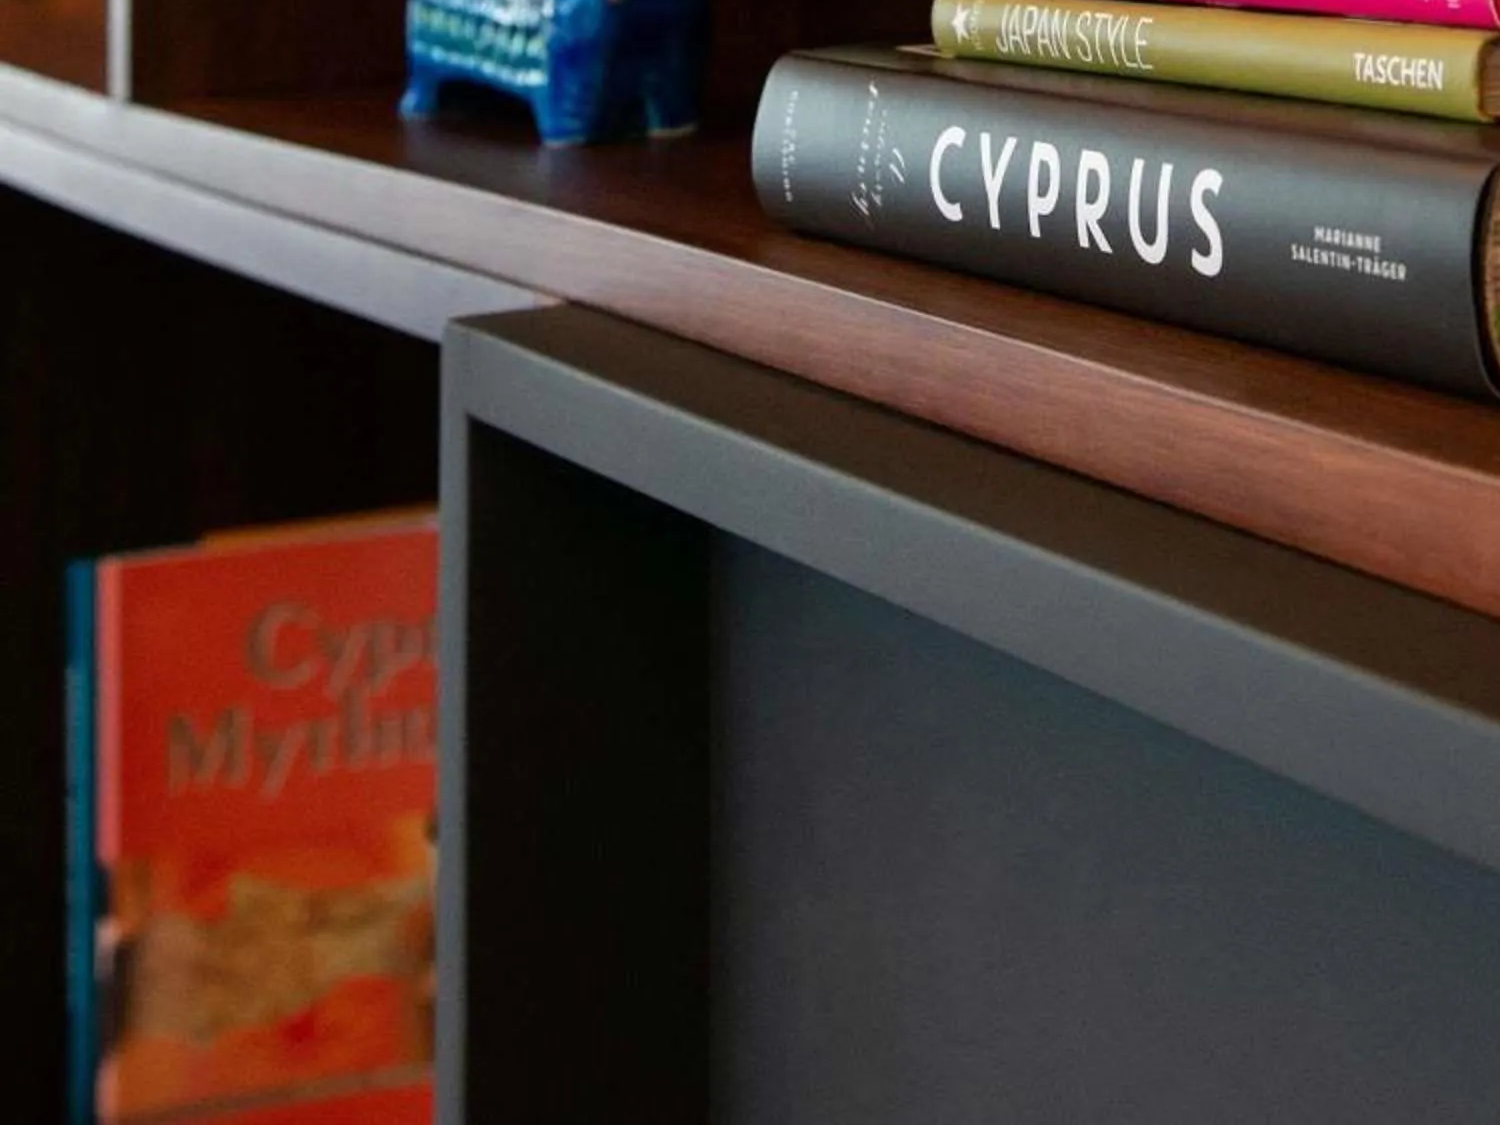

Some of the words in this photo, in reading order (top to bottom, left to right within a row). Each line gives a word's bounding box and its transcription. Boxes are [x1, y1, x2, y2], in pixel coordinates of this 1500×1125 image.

[996, 3, 1072, 60] JAPAN
[1075, 10, 1154, 70] STYLE
[1353, 52, 1445, 91] TASCHEN
[929, 125, 1224, 277] CYPRUS
[1313, 225, 1382, 254] MARIANNE
[243, 601, 437, 701] Cyp
